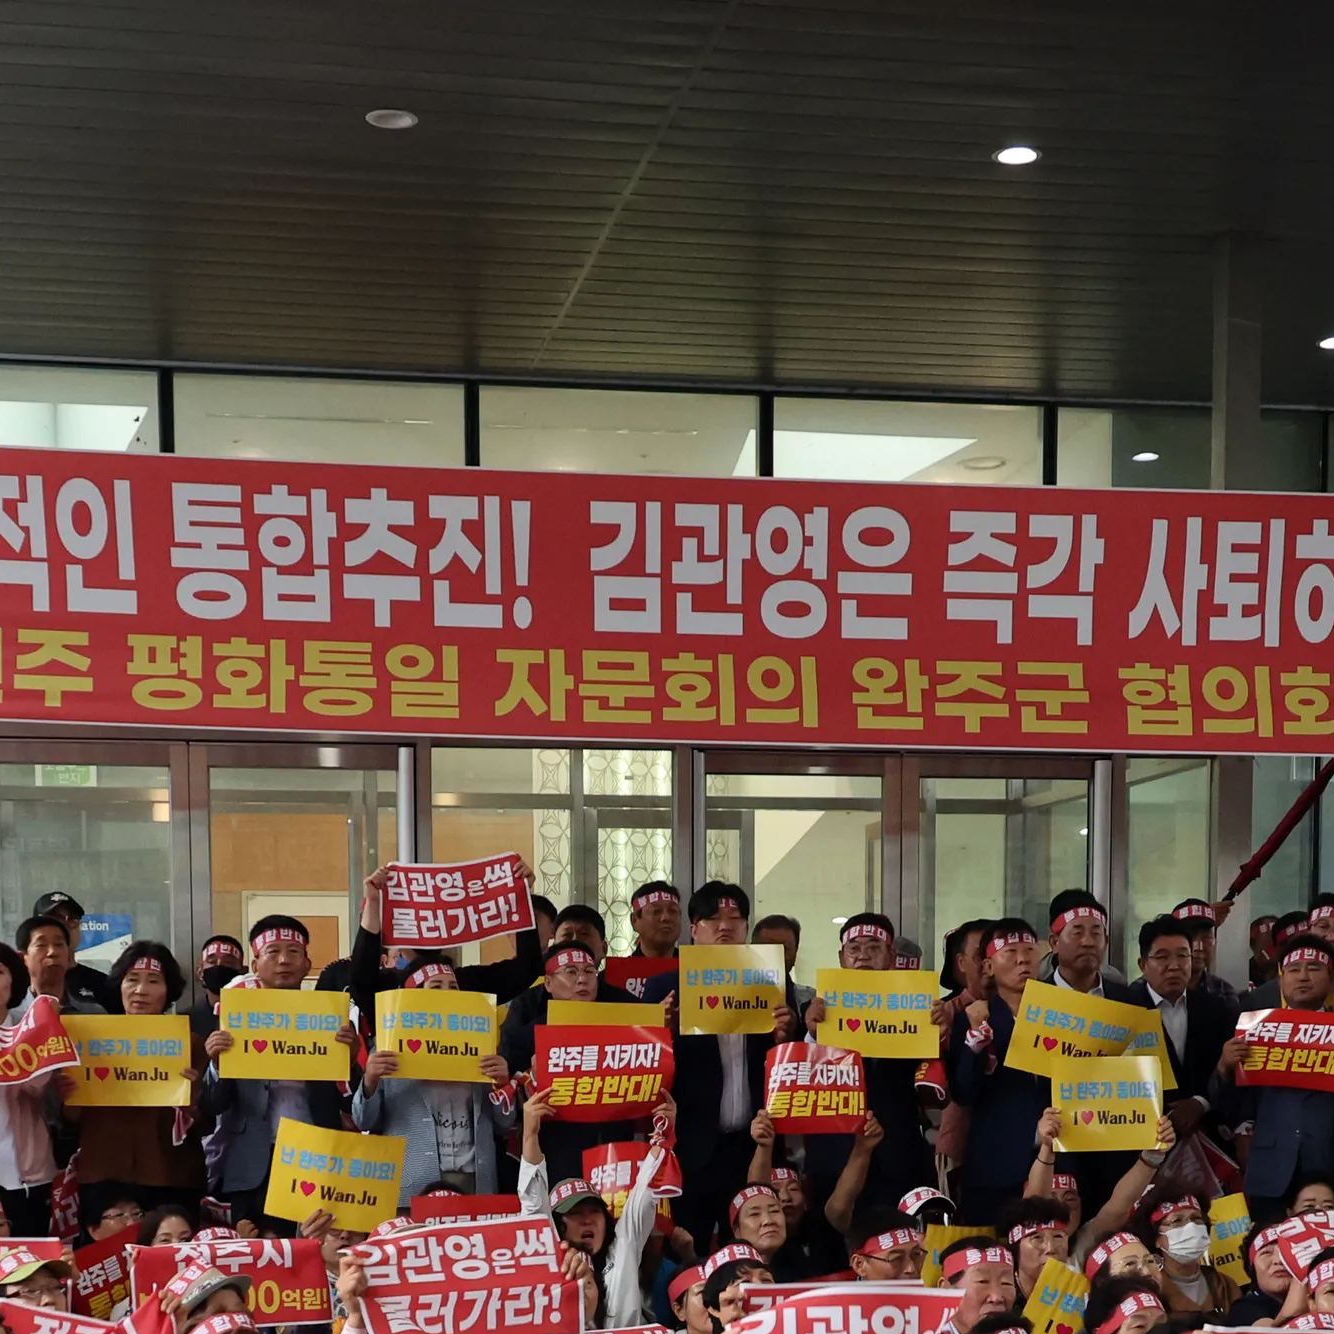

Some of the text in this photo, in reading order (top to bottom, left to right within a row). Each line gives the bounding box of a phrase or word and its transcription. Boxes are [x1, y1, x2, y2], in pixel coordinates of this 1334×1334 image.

[169, 481, 532, 630] 통합추진!
[589, 500, 913, 641] 김관영은
[942, 509, 1105, 645] 즉각
[127, 634, 460, 719] 평화통일
[494, 646, 819, 727] 자문회의
[851, 656, 1090, 734] 완주군
[391, 892, 520, 939] 물러가라!
[1064, 908, 1106, 923] 통합반
[686, 970, 698, 985] 난
[702, 969, 738, 985] 완주가
[824, 992, 839, 1007] 난
[842, 992, 882, 1010] 완주가
[228, 1012, 243, 1029] 난
[247, 1013, 291, 1030] 완주가
[383, 1012, 396, 1029] 난
[401, 1013, 443, 1031] 완주가
[548, 1043, 660, 1072] 완주를 지키자!
[769, 1060, 859, 1089] 완주를 지키자!
[548, 1074, 662, 1106] 통합반대!
[768, 1089, 864, 1118] 통합반대!
[1060, 1082, 1074, 1099] 난
[1077, 1082, 1113, 1100] 완주가
[281, 1146, 295, 1164] 난
[299, 1150, 344, 1174] 완주가
[376, 1283, 562, 1334] 물러가라!
